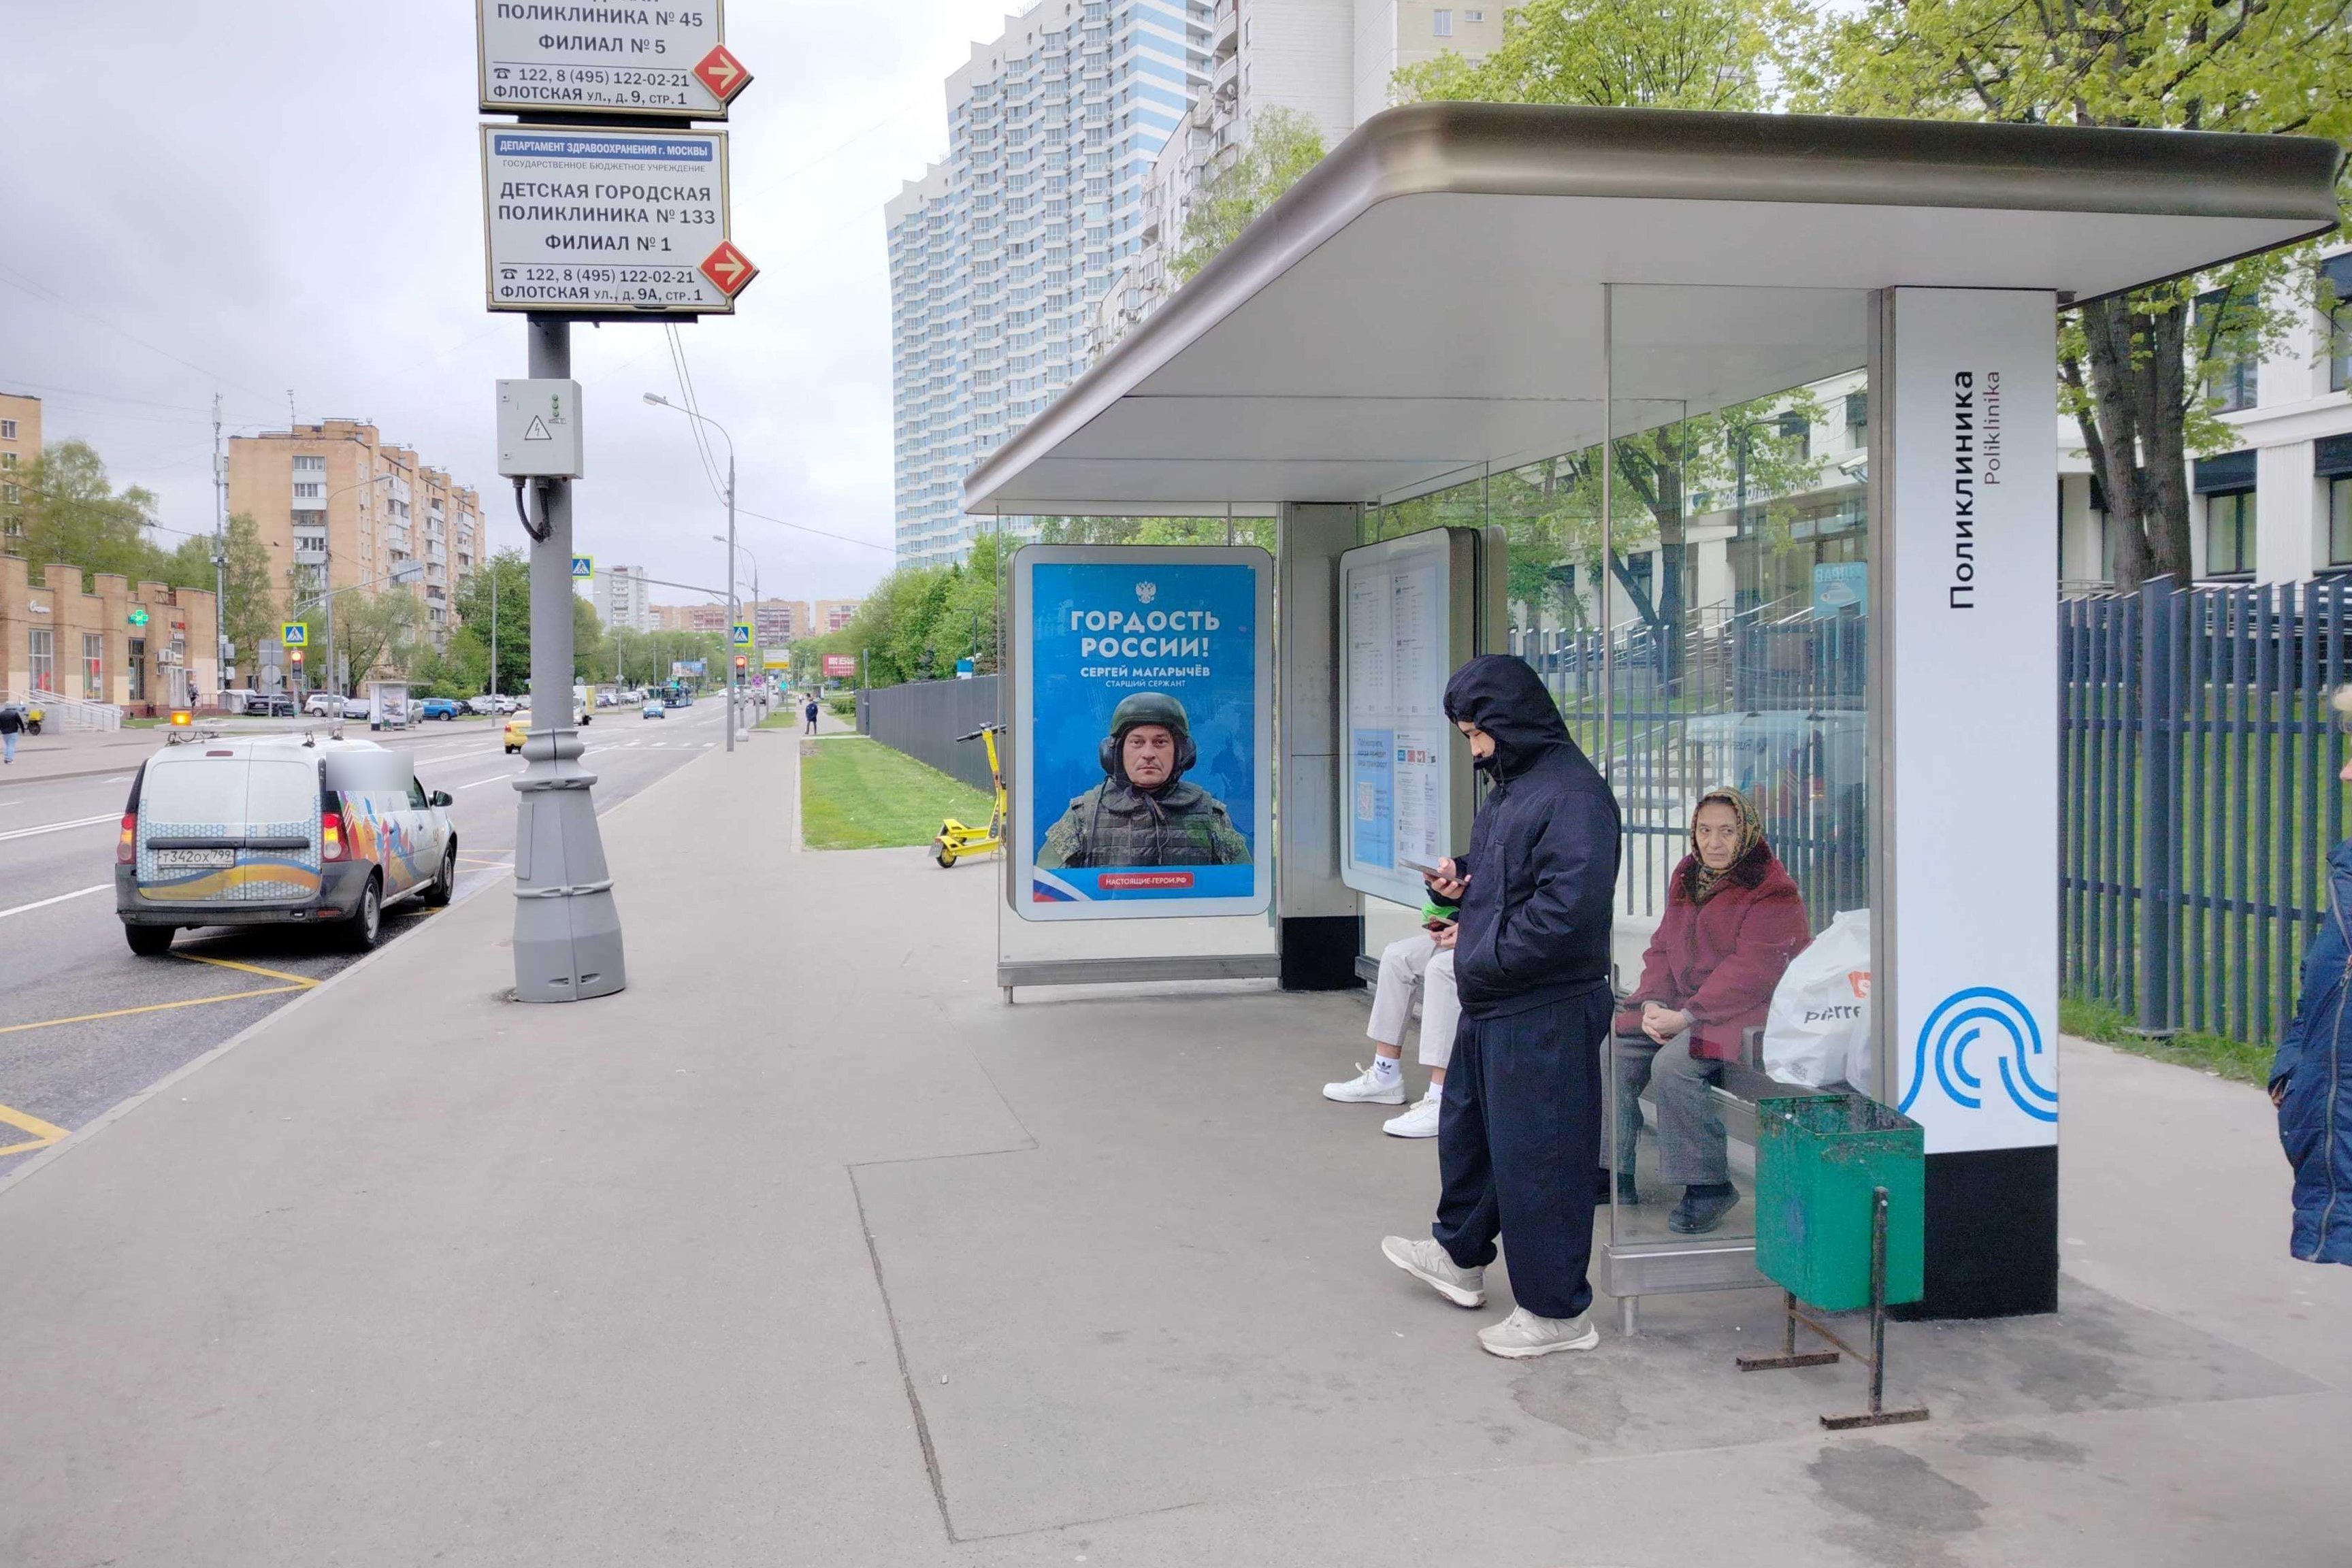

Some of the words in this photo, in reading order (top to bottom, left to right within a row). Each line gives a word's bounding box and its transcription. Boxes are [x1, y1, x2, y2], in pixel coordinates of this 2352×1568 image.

[497, 3, 649, 25] ПОЛИКЛИНИКА
[656, 11, 674, 26] №
[679, 12, 703, 27] 45
[539, 34, 623, 52] ФИЛИАЛ
[631, 38, 649, 52] №
[655, 39, 666, 54] 5
[519, 68, 552, 83] 122,
[557, 69, 566, 82] 8
[570, 69, 609, 86] (495)
[614, 71, 689, 87] 122-02-21
[493, 85, 583, 101] ФЛОТСКАЯ
[631, 90, 645, 105] 9,
[678, 92, 687, 105] 1
[500, 140, 565, 152] ДЕПАРТАМЕНТ
[567, 142, 657, 154] ЗДРАВООХРАНЕНИЯ
[667, 145, 708, 157] МОСКВЫ
[503, 159, 587, 169] ГОСУДАРСТВЕННОЕ
[589, 161, 646, 172] БЮДЖЕТНОЕ
[647, 163, 706, 173] УЧРЕЖДЕНИЕ
[500, 182, 589, 199] ДЕТСКАЯ
[595, 184, 710, 203] ГОРОДСКАЯ
[498, 206, 649, 223] ПОЛИКЛИНИКА
[656, 209, 675, 223] №
[681, 210, 715, 225] 133
[545, 235, 630, 251] ФИЛИАЛ
[637, 237, 655, 251] №
[661, 238, 672, 251] 1
[527, 268, 559, 283] 122,
[564, 269, 572, 281] 8
[577, 268, 615, 284] (495)
[620, 270, 694, 283] 122-02-21
[500, 285, 589, 299] ФЛОТСКАЯ
[694, 289, 703, 301] 1
[1983, 371, 2001, 485] Poliklinika
[1950, 371, 1974, 609] Поликлиника
[1071, 610, 1220, 634] ГОРДОСТЬ
[1081, 638, 1209, 658] РОССИИ!
[1080, 664, 1128, 677] СЕРГЕЙ
[1132, 664, 1210, 677] МАГАРЫЧЁВ
[1105, 679, 1145, 688] СТАРШИЙ
[1148, 680, 1186, 688] СЕРЖАНТ
[1105, 876, 1187, 886] НАСТОЯЩИЕ-ГЕРОИ.РФ
